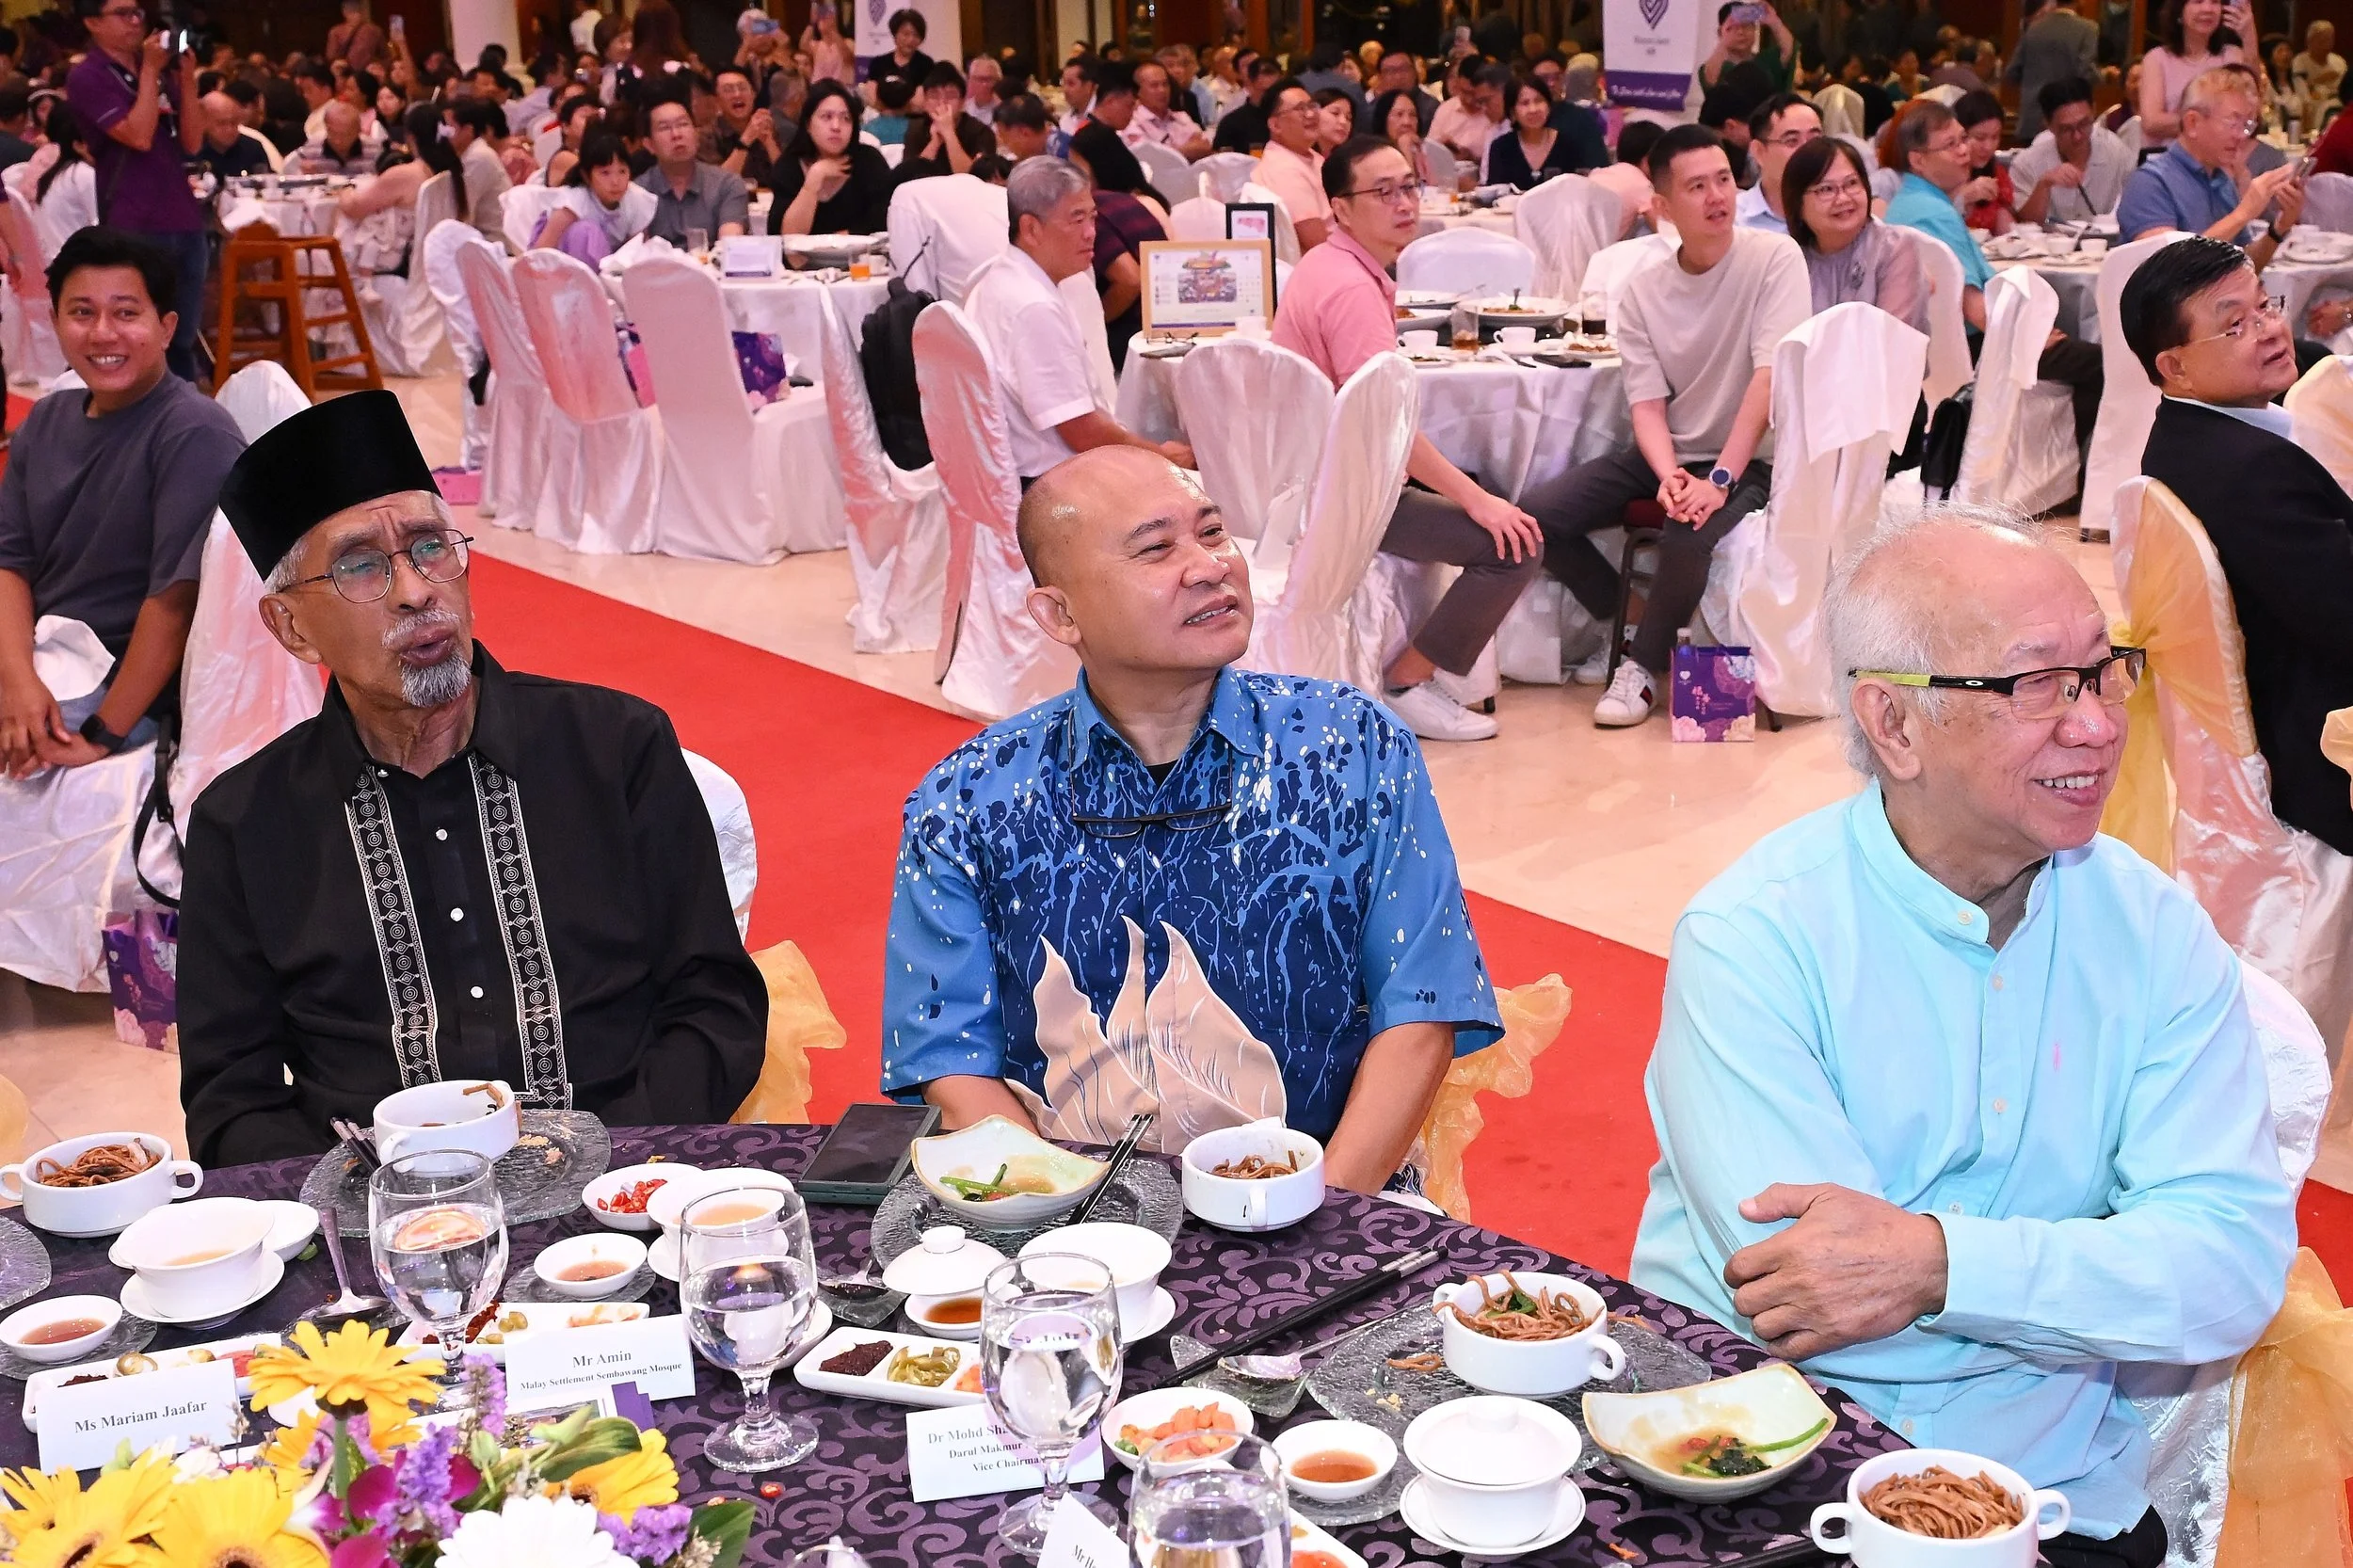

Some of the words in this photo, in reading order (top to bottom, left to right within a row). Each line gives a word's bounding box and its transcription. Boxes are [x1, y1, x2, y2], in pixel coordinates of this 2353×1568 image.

[572, 1355, 593, 1368] Mr
[596, 1351, 632, 1365] Amin
[520, 1381, 547, 1390] Malay
[550, 1374, 594, 1386] Settlement
[597, 1368, 648, 1380] Sembawang
[649, 1363, 682, 1373] Mosque
[74, 1419, 97, 1433] Ms
[101, 1410, 158, 1429] Mariam
[162, 1400, 207, 1417] Jaafar
[928, 1433, 943, 1444] Dr
[948, 1427, 983, 1442] Mohd
[949, 1447, 977, 1459] Darul
[981, 1442, 1023, 1454] Makmur
[973, 1463, 994, 1472] Vice
[997, 1457, 1042, 1469] Chairma
